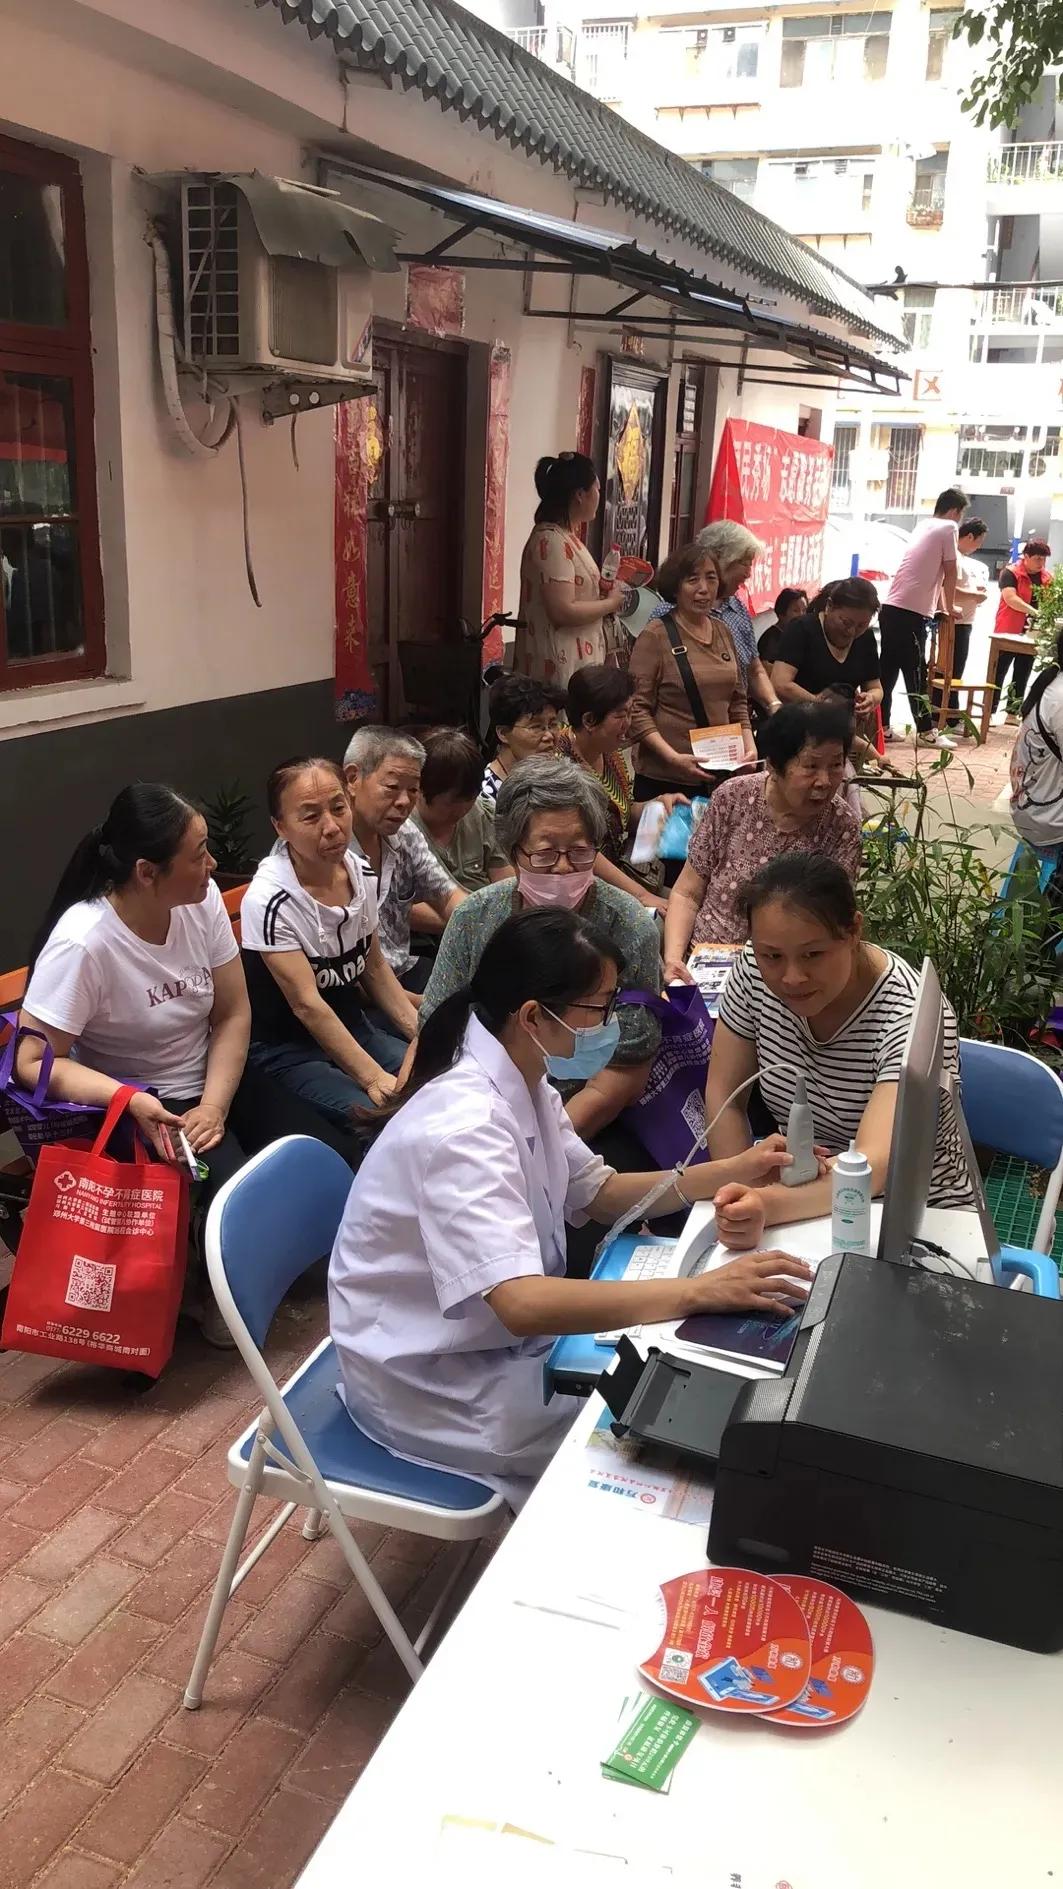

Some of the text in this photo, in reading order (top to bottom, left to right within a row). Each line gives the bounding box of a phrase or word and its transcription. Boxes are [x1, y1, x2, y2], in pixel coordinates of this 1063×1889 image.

[78, 1177, 164, 1202] 南阳不孕不育症医院
[131, 1201, 163, 1210] HOSPITAL
[62, 1325, 90, 1339] 6229
[92, 1331, 121, 1345] 6622
